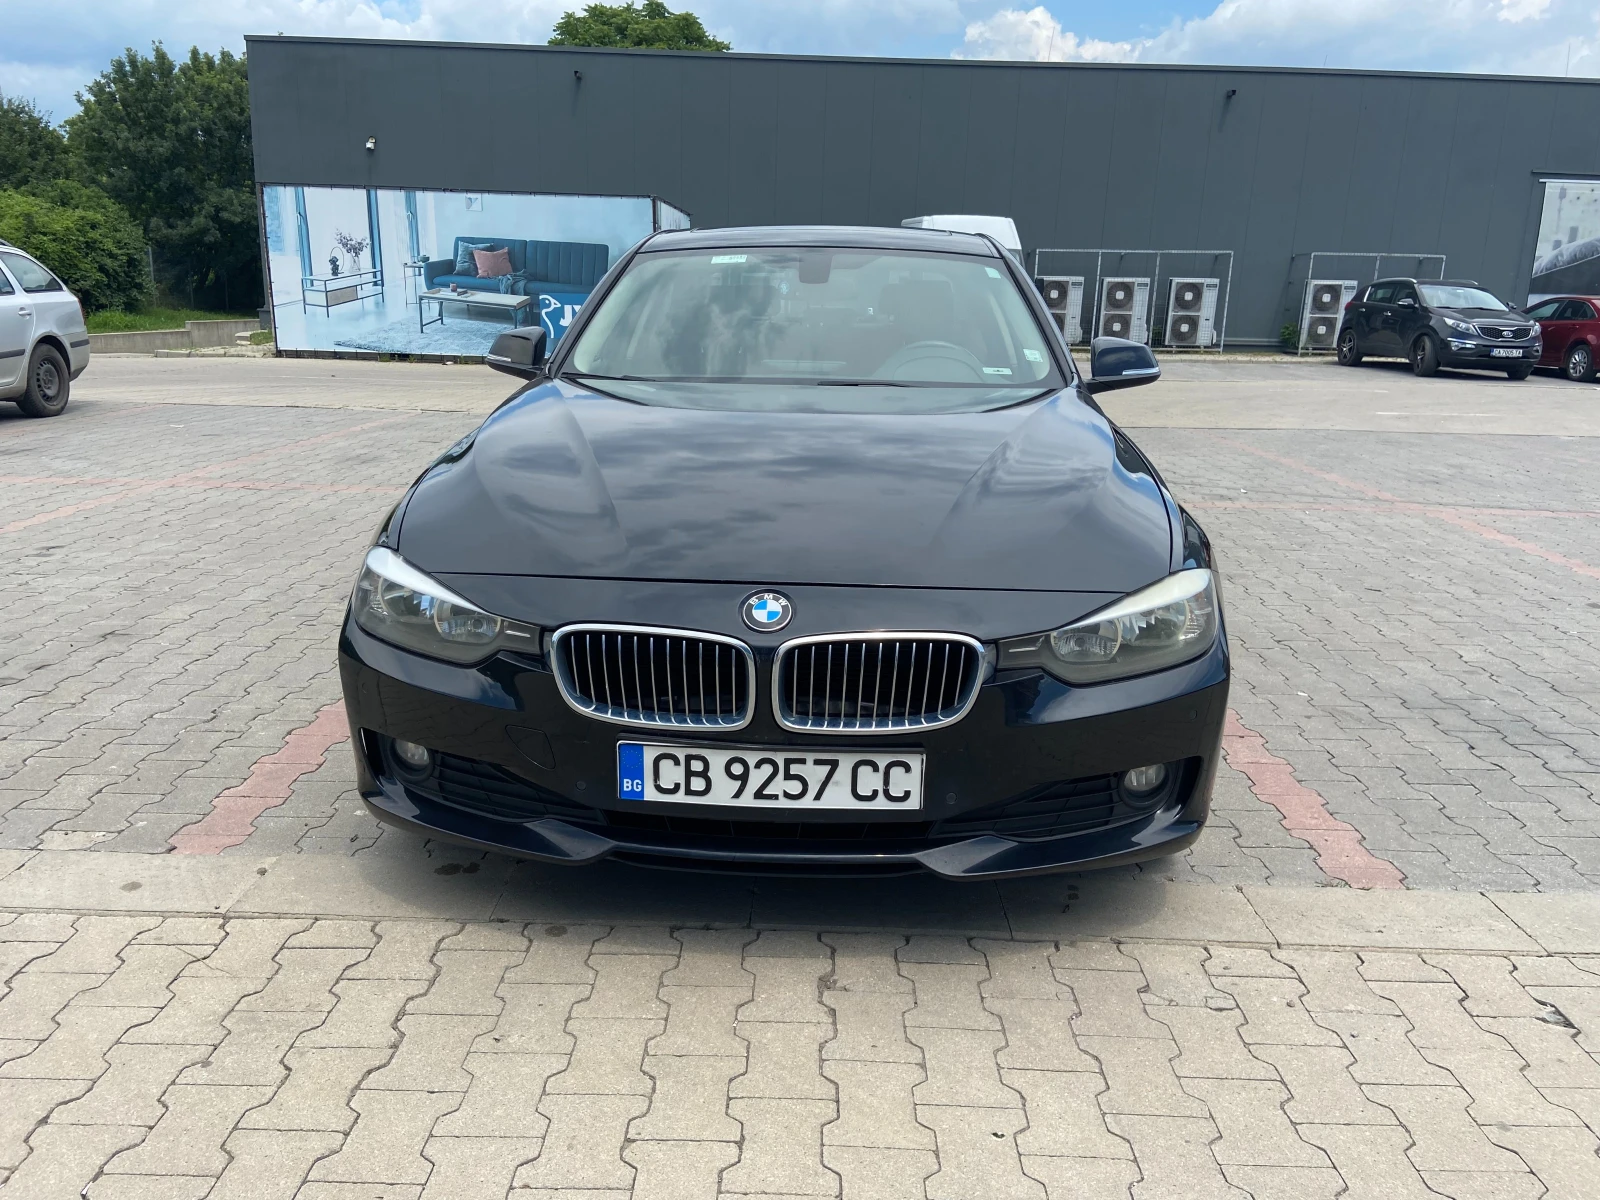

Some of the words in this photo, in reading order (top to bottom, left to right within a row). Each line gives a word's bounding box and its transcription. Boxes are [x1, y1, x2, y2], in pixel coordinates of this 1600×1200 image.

[749, 594, 788, 605] BMW
[652, 753, 712, 797] CB
[724, 757, 840, 800] 9257
[850, 758, 912, 802] CC
[623, 778, 642, 792] BG
